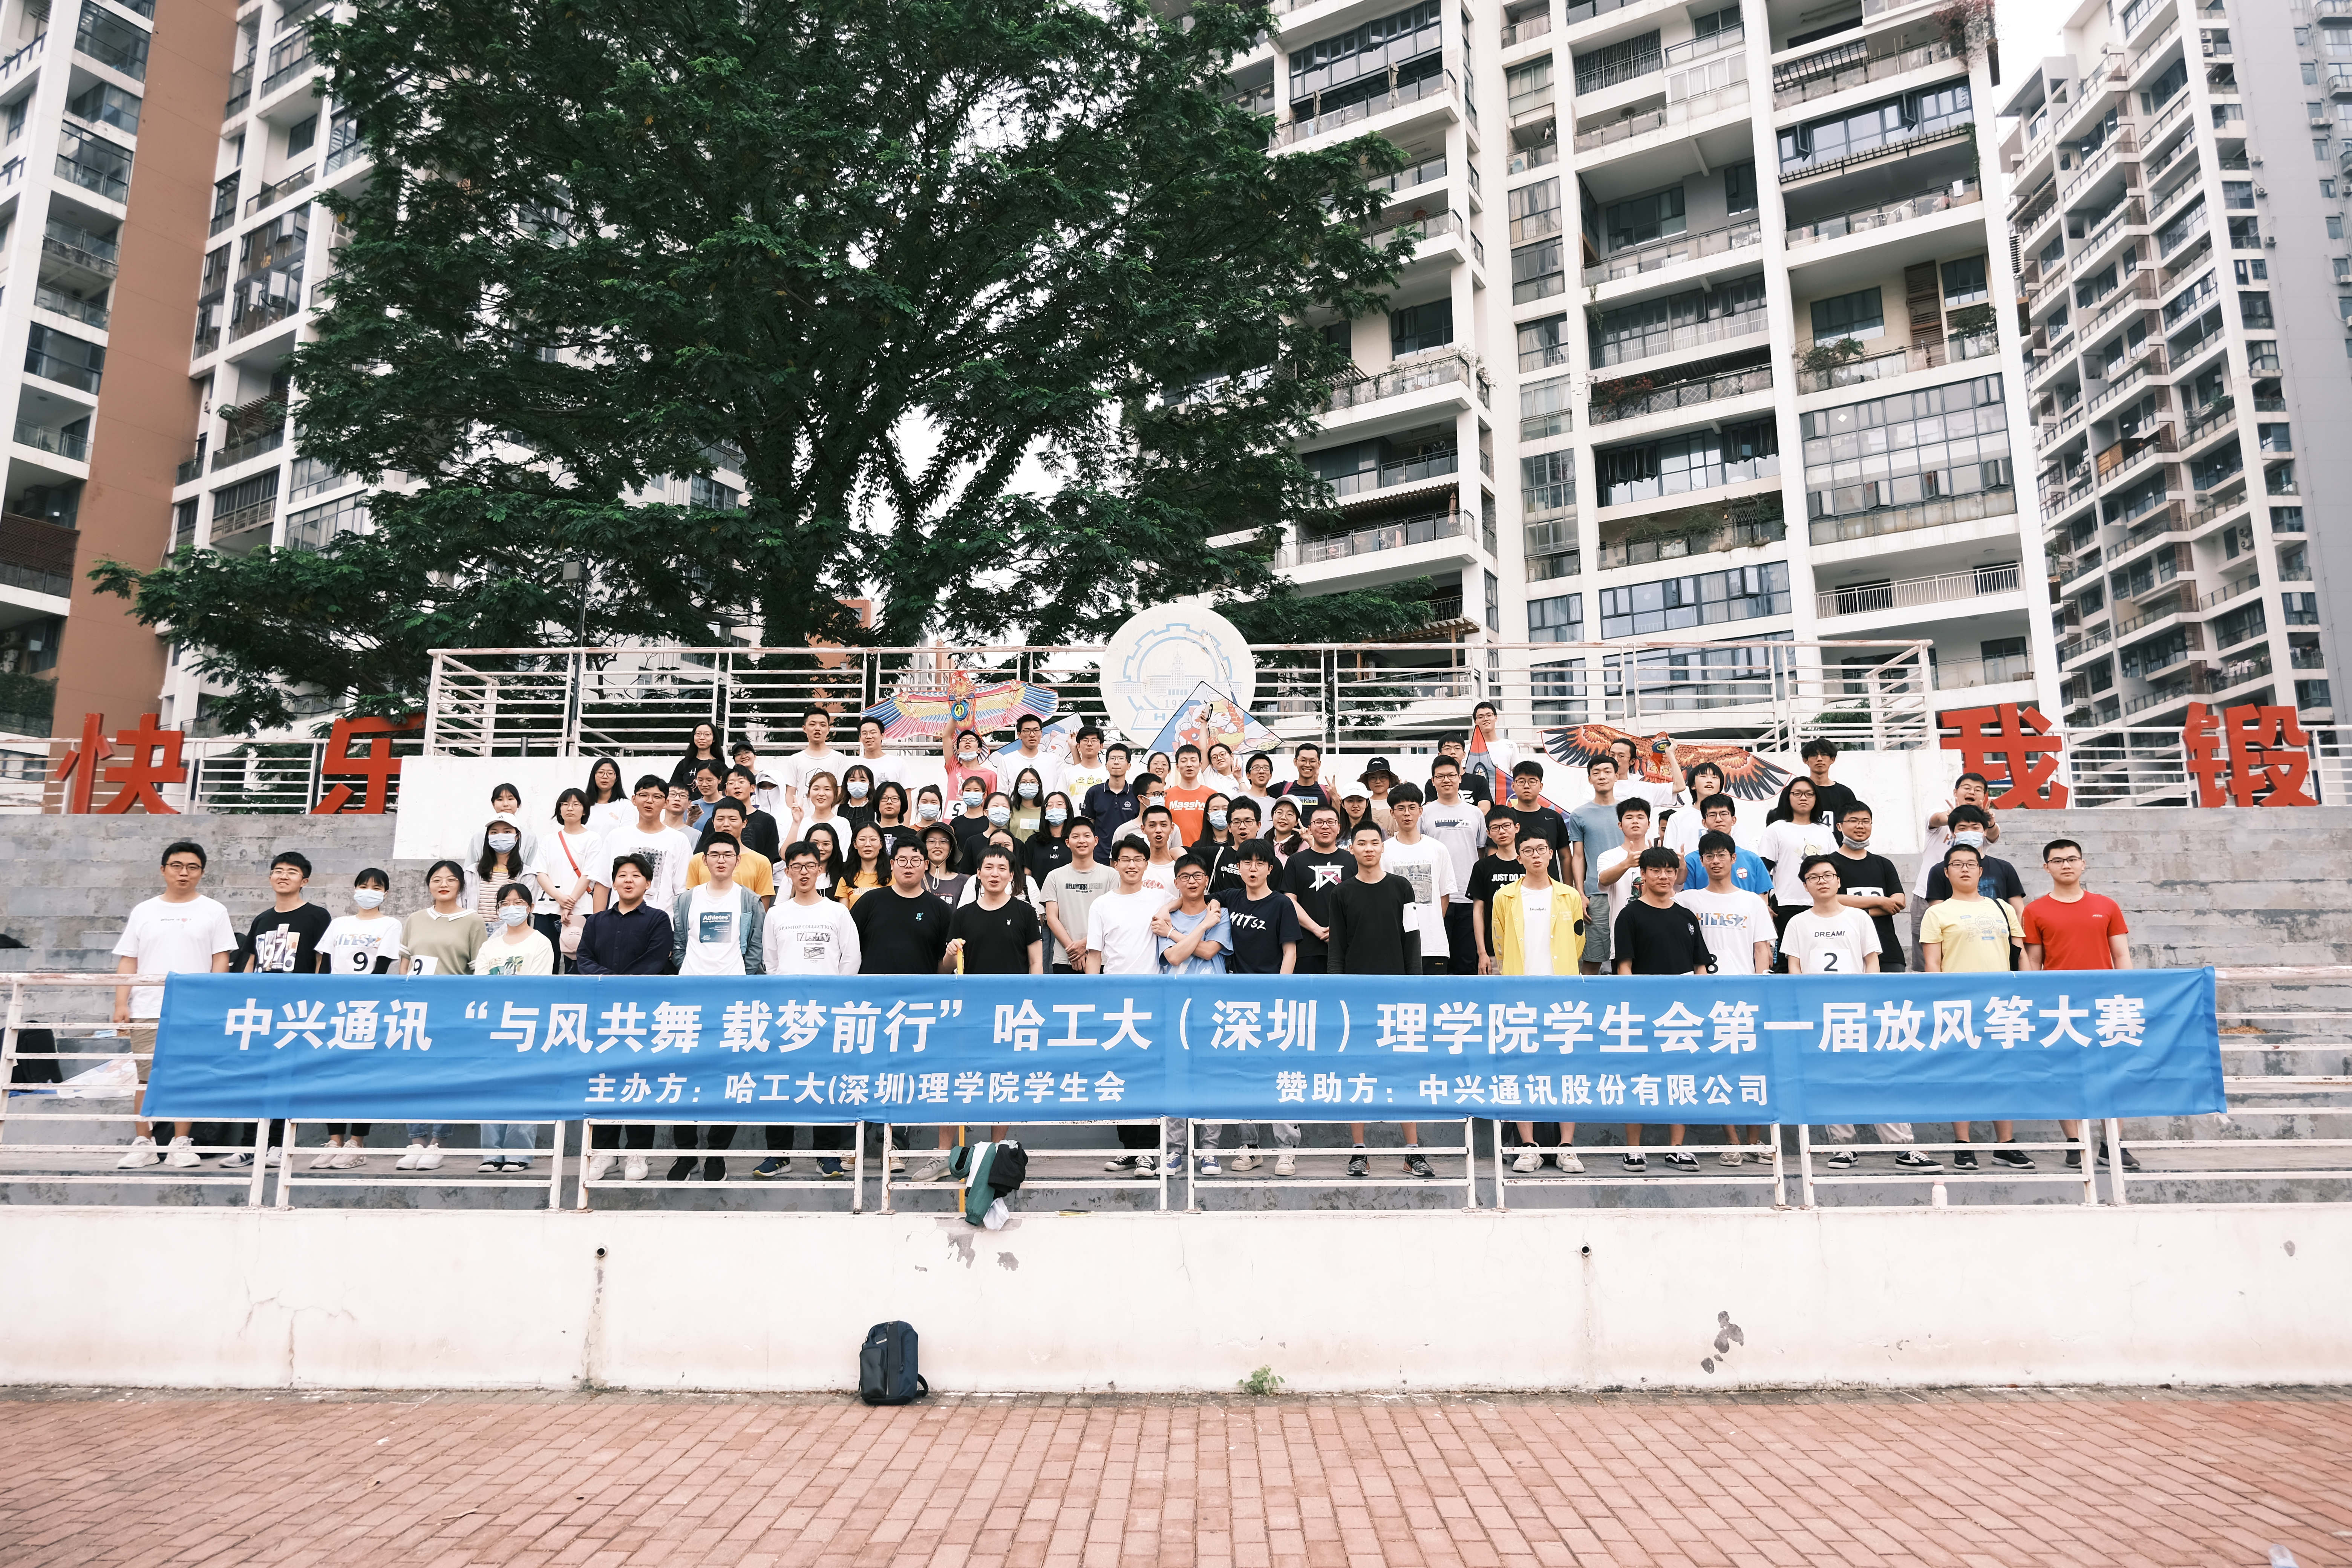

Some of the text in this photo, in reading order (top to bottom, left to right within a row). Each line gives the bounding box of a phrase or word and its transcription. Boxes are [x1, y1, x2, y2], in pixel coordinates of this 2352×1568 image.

[1165, 699, 1183, 708] 192
[353, 952, 368, 972] 9
[413, 959, 423, 975] 9
[1824, 952, 1838, 972] 2
[225, 998, 432, 1051] 中兴通讯
